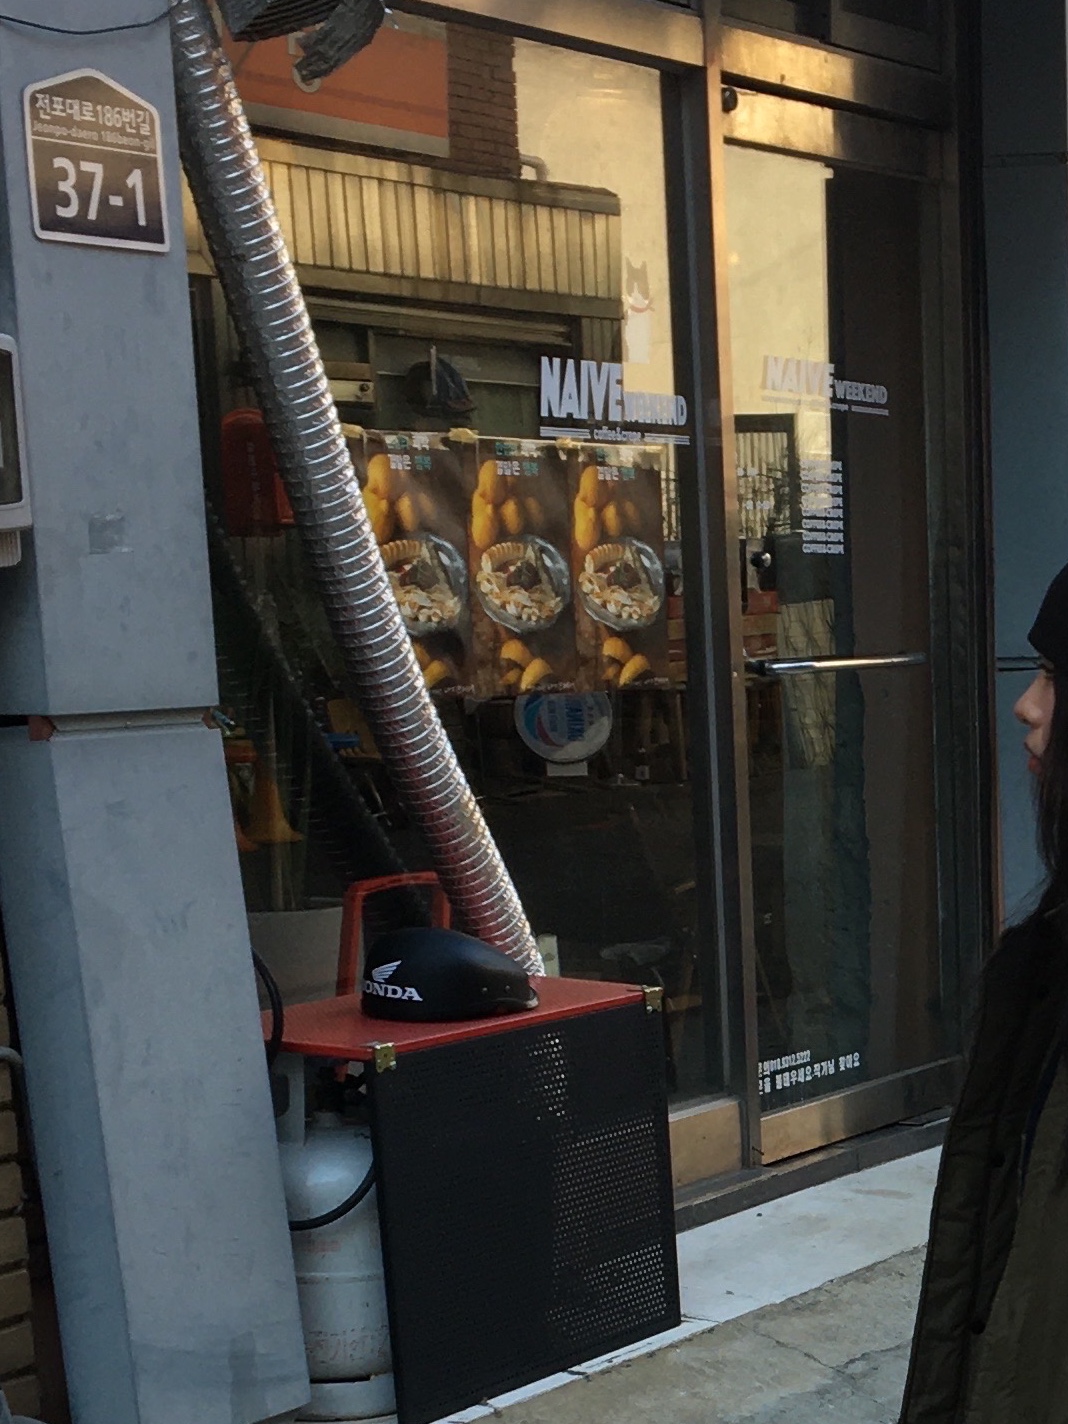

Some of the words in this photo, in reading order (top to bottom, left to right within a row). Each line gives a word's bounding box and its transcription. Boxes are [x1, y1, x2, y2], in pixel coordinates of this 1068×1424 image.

[52, 156, 147, 227] 37-1
[540, 355, 622, 421] NAIVE
[763, 355, 835, 398] NAIVE
[834, 379, 888, 405] WEEKEND
[362, 980, 424, 1002] ONDA
